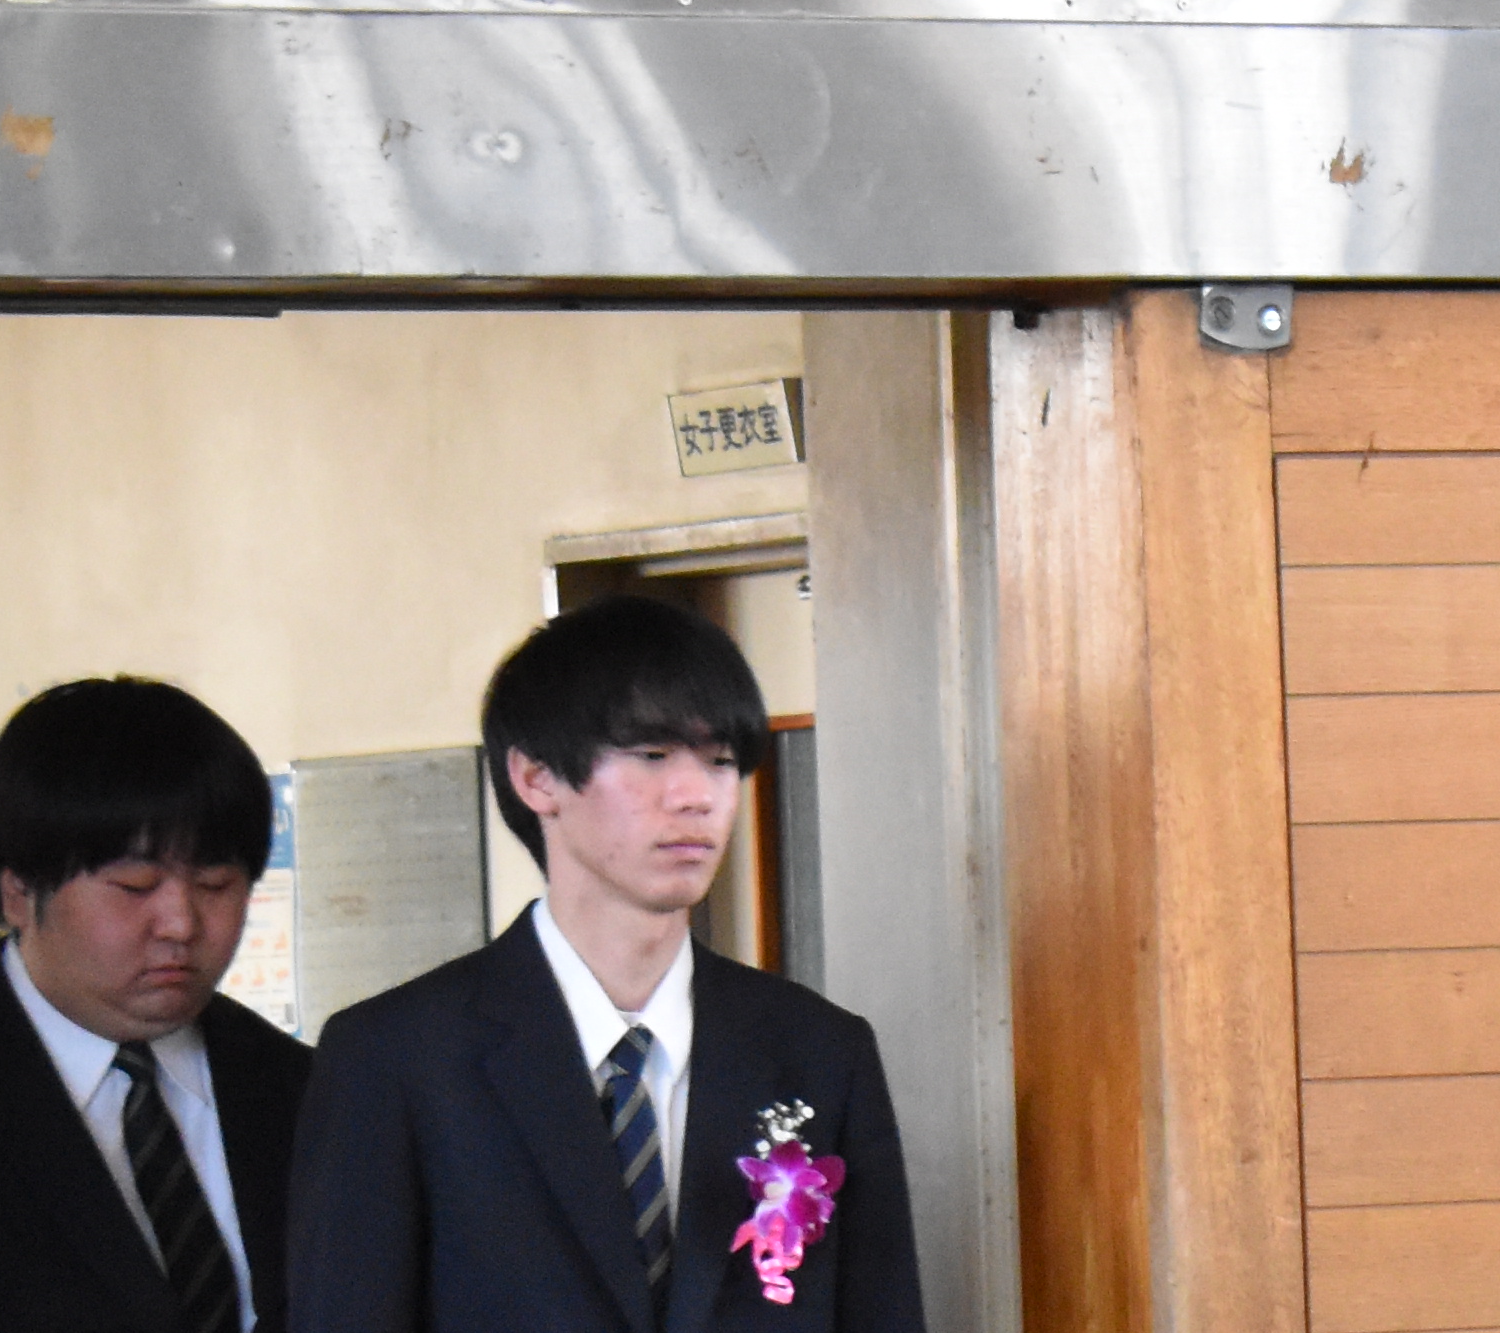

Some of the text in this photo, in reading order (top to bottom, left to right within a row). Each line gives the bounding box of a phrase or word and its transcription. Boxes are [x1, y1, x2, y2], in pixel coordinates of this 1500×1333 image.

[679, 402, 783, 456] 女子更衣室
